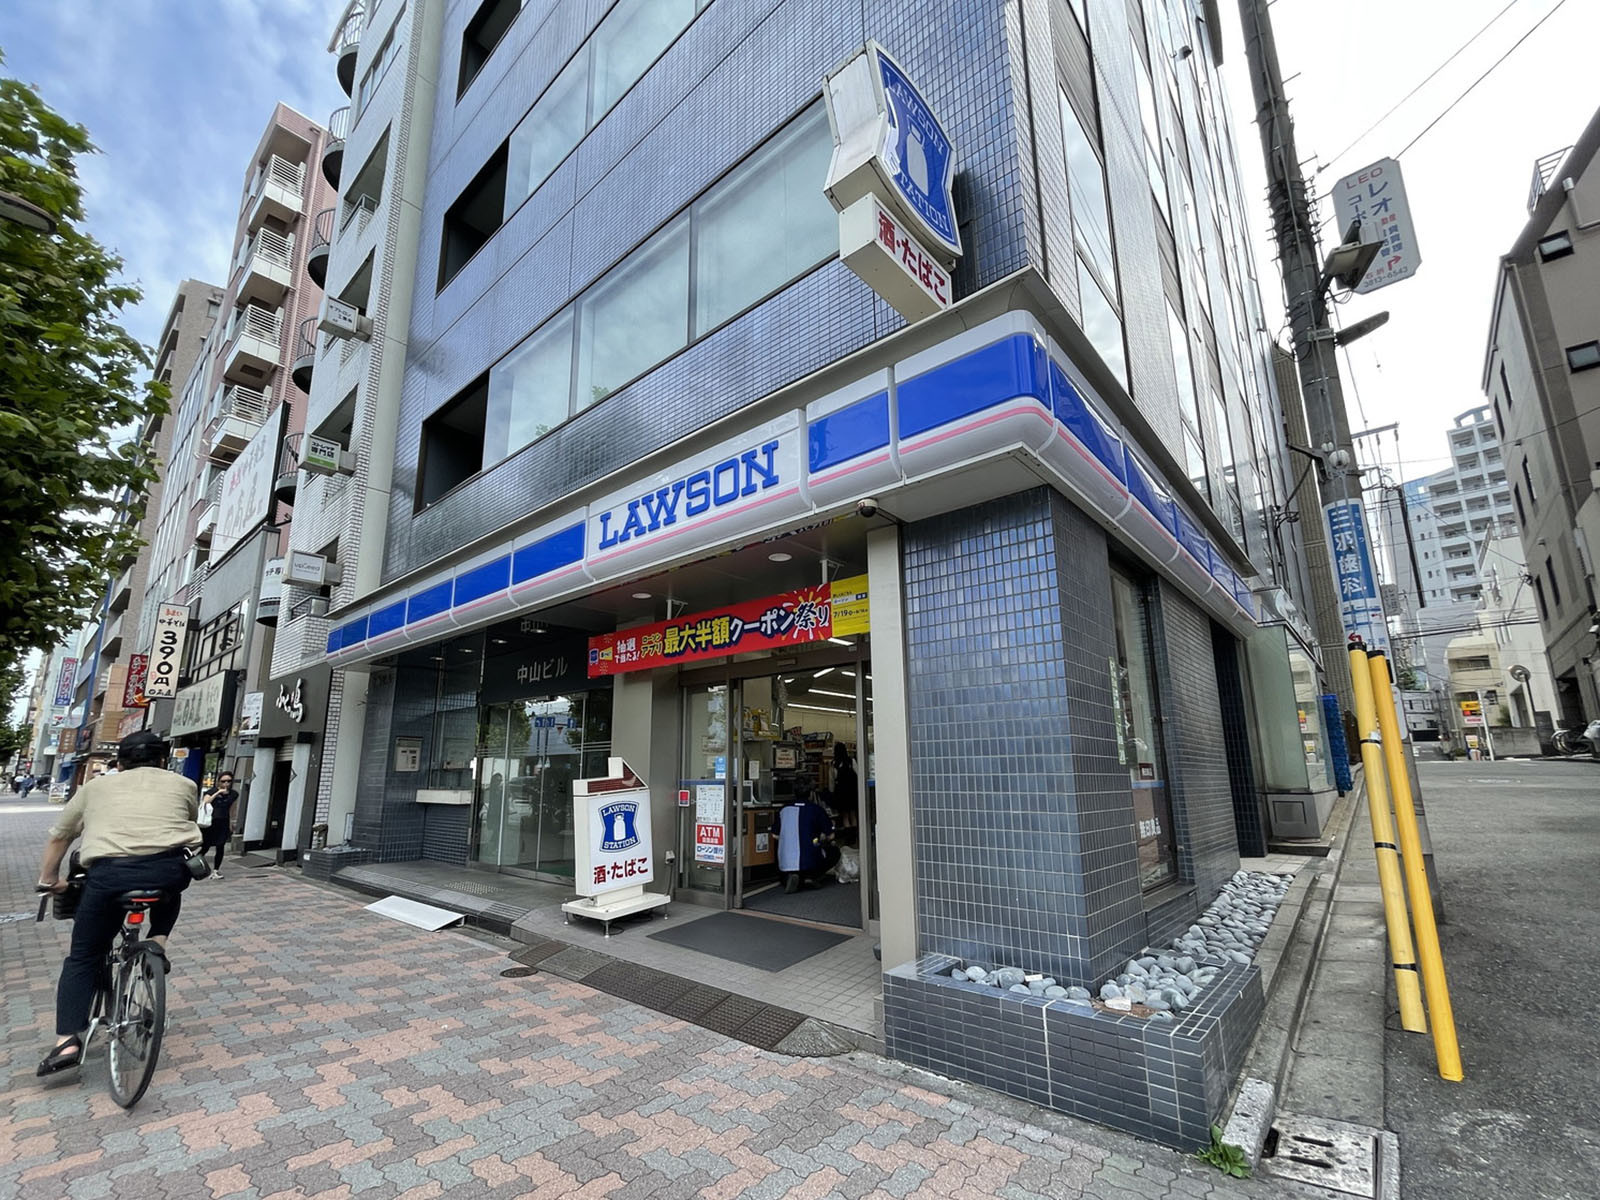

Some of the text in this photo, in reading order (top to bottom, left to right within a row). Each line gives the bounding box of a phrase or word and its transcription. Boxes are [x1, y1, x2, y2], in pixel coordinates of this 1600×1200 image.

[885, 72, 944, 154] LAWSON
[1346, 167, 1383, 190] LEO
[878, 210, 947, 304] 酒・たばこ
[311, 446, 334, 459] 専門店
[599, 439, 780, 550] LAWSON
[640, 640, 663, 659] アプリ
[641, 632, 662, 645] ローソン
[153, 630, 178, 687] 390円
[517, 656, 568, 685] 中山ビル
[602, 803, 635, 817] LAWSON
[603, 836, 637, 850] STATION
[700, 827, 720, 839] ATM
[594, 857, 649, 885] 酒・たばこ
